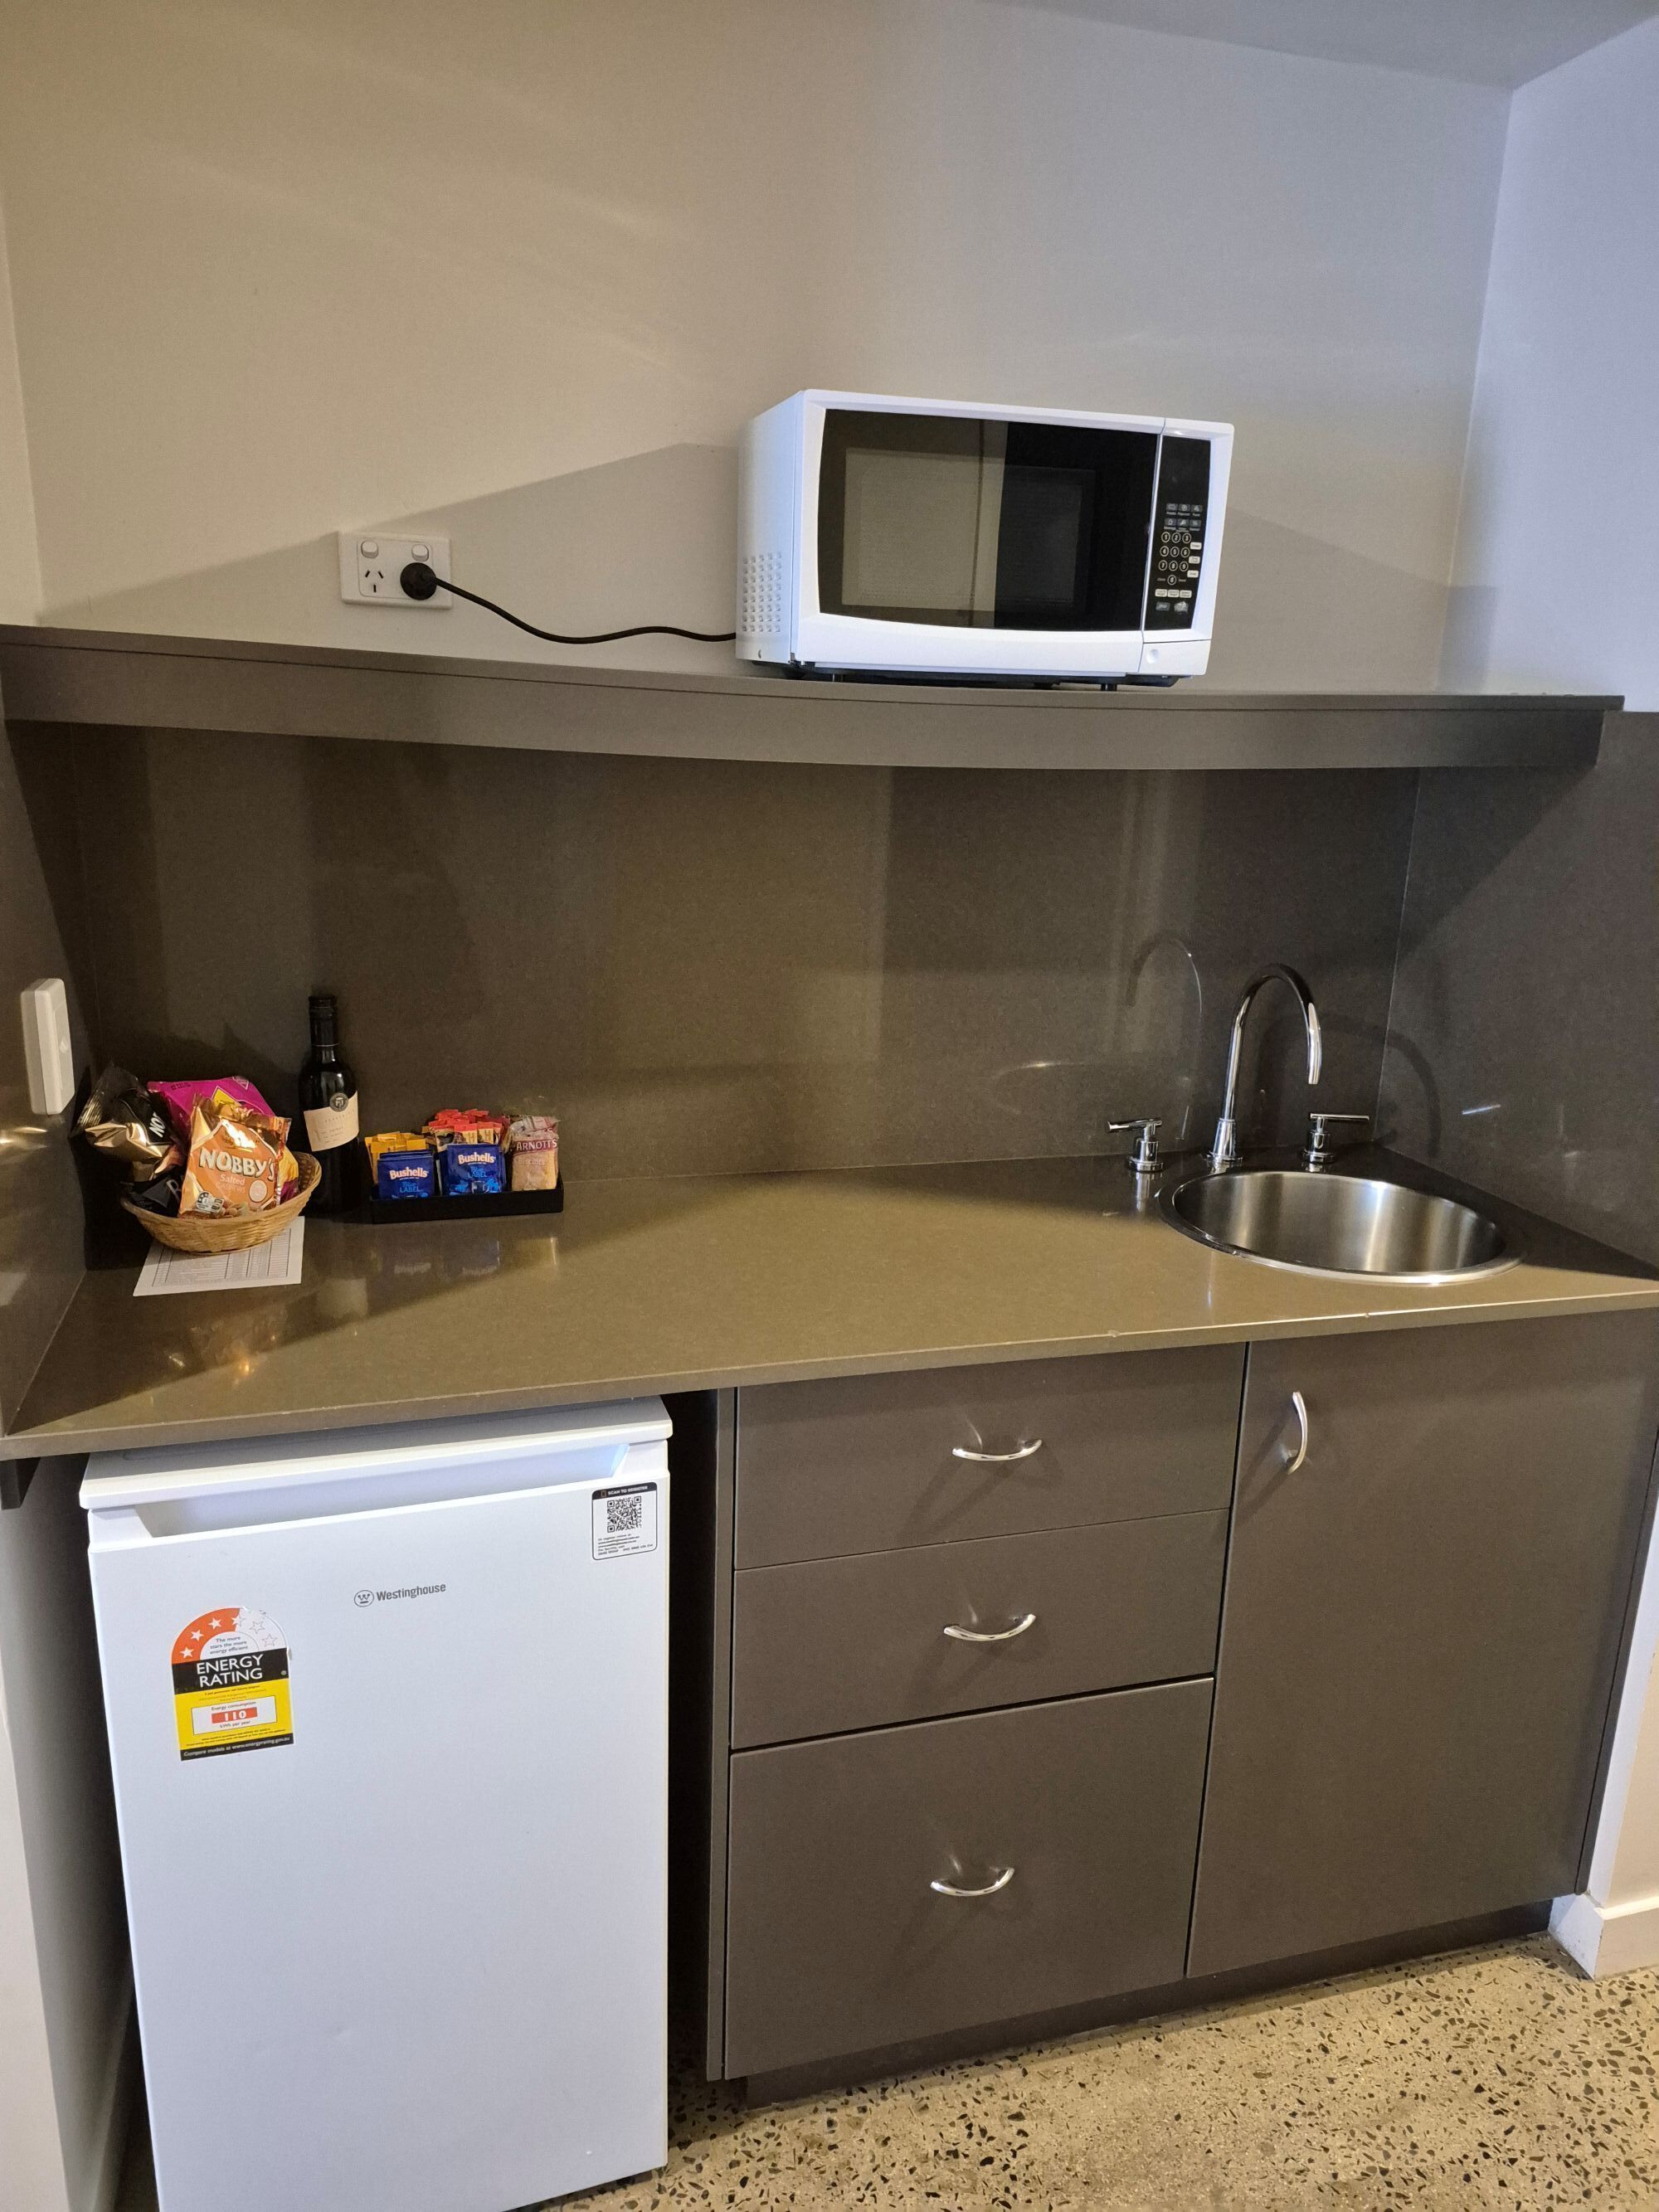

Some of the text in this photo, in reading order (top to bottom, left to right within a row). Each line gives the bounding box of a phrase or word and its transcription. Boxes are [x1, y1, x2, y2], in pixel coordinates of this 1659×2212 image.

[199, 1147, 275, 1182] NOBBY'S
[458, 1152, 495, 1164] Bushells
[220, 1174, 246, 1185] Salted
[389, 1166, 428, 1180] Bushells
[400, 1185, 419, 1194] LABEL
[376, 1583, 446, 1602] Westinghouse
[197, 1653, 264, 1675] ENERGY
[199, 1668, 263, 1688] RATING
[224, 1710, 247, 1722] 110
